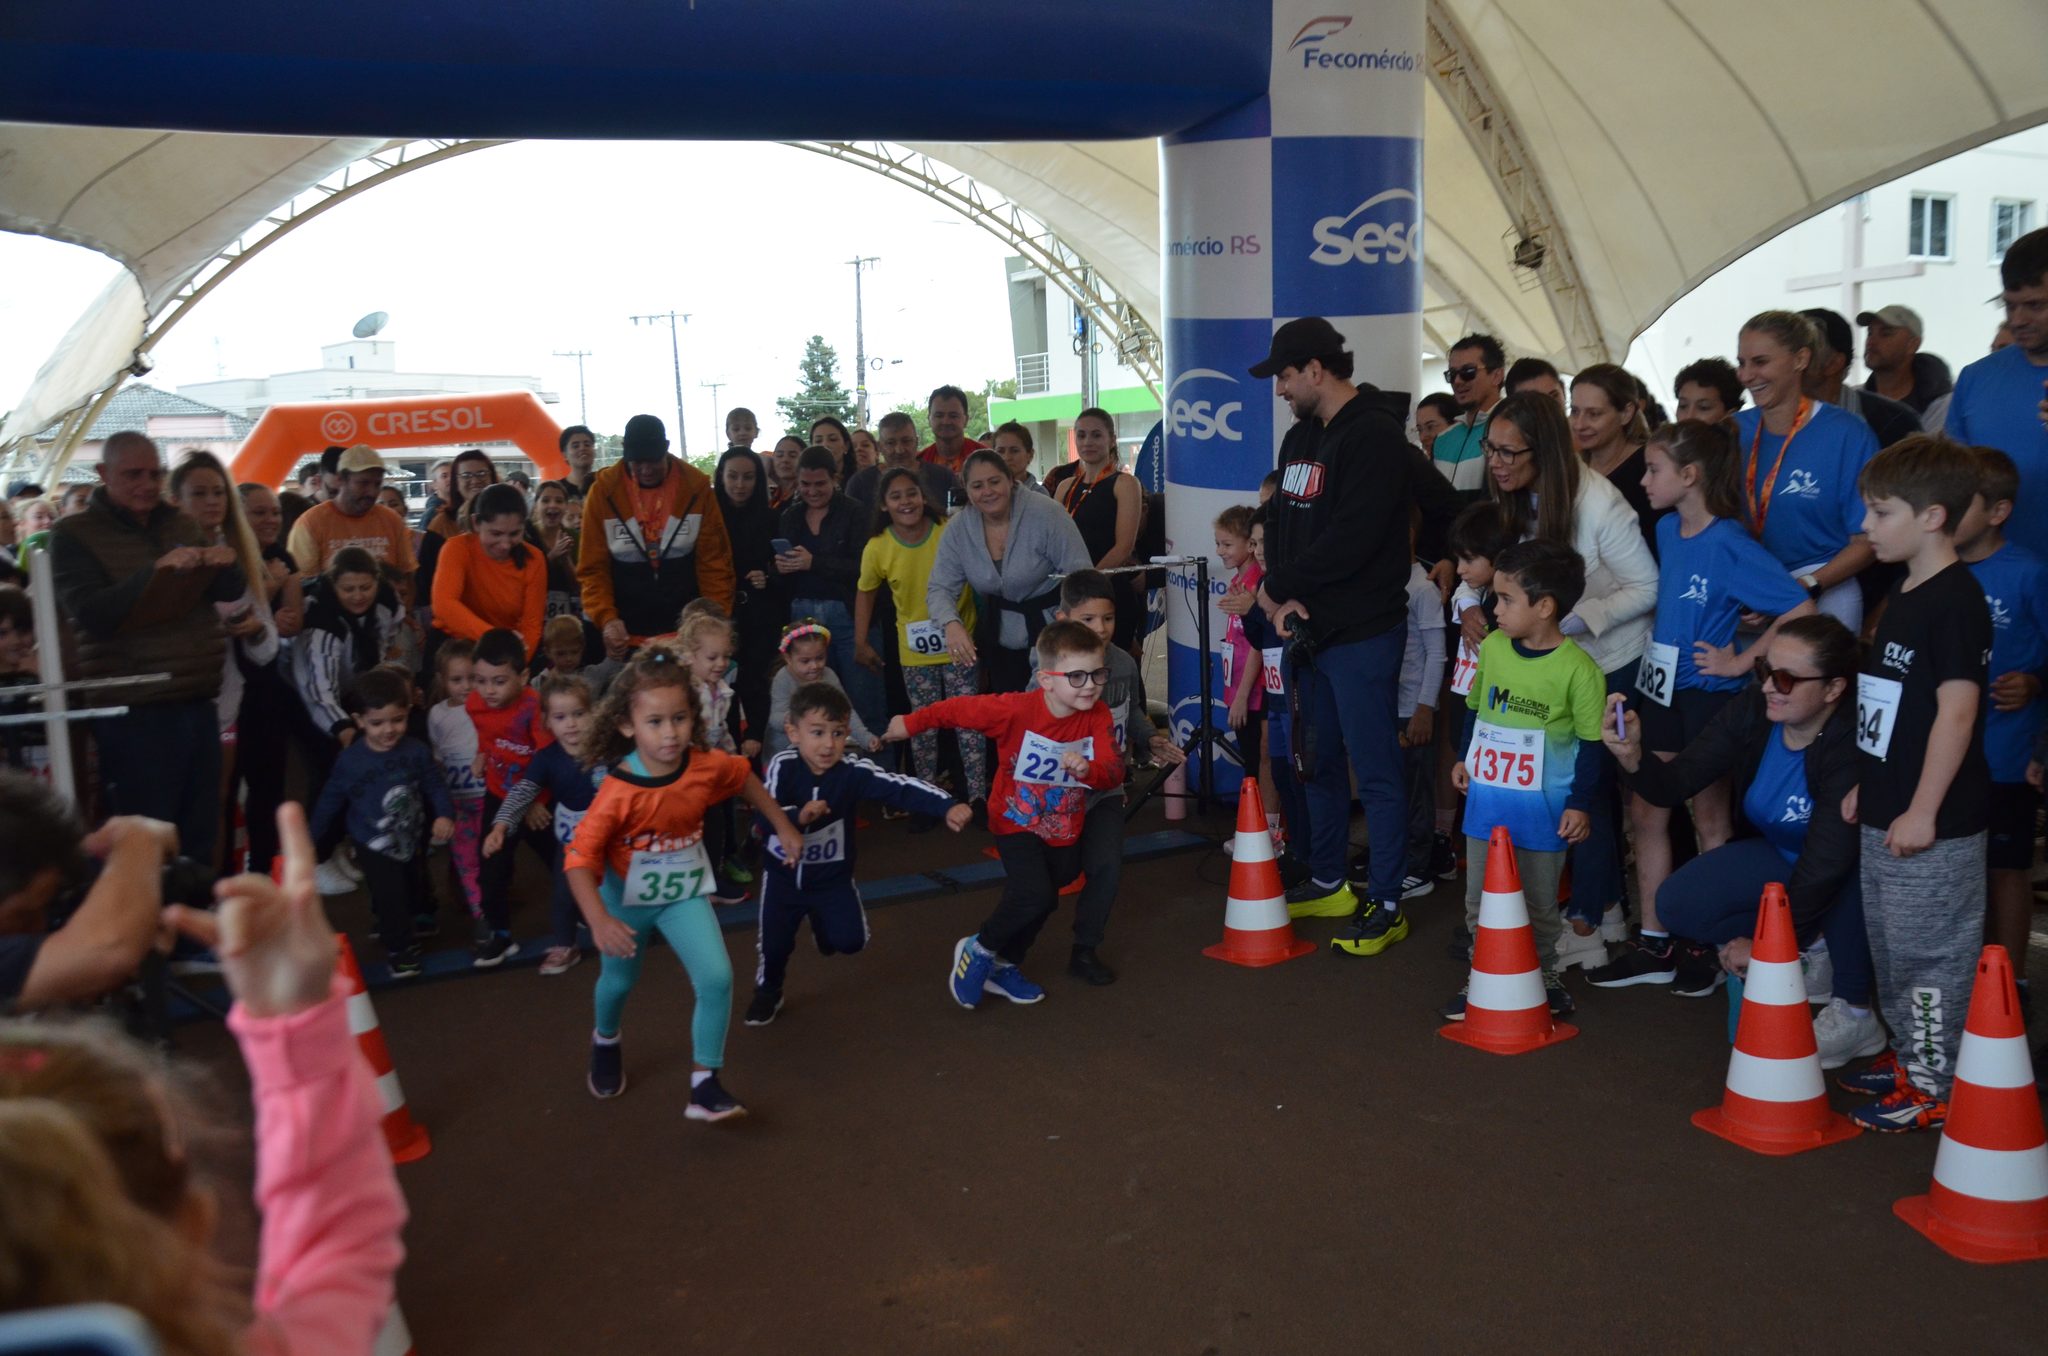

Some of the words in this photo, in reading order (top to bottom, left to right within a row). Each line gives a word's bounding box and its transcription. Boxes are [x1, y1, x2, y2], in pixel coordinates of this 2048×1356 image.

[1303, 47, 1414, 72] Fecomércio
[1230, 234, 1261, 255] RS
[367, 406, 494, 436] CRESOL
[1166, 398, 1243, 441] esc
[915, 634, 942, 654] 99
[1509, 694, 1551, 712] ACADEMIA
[1473, 745, 1535, 786] 1375
[638, 867, 705, 901] 357
